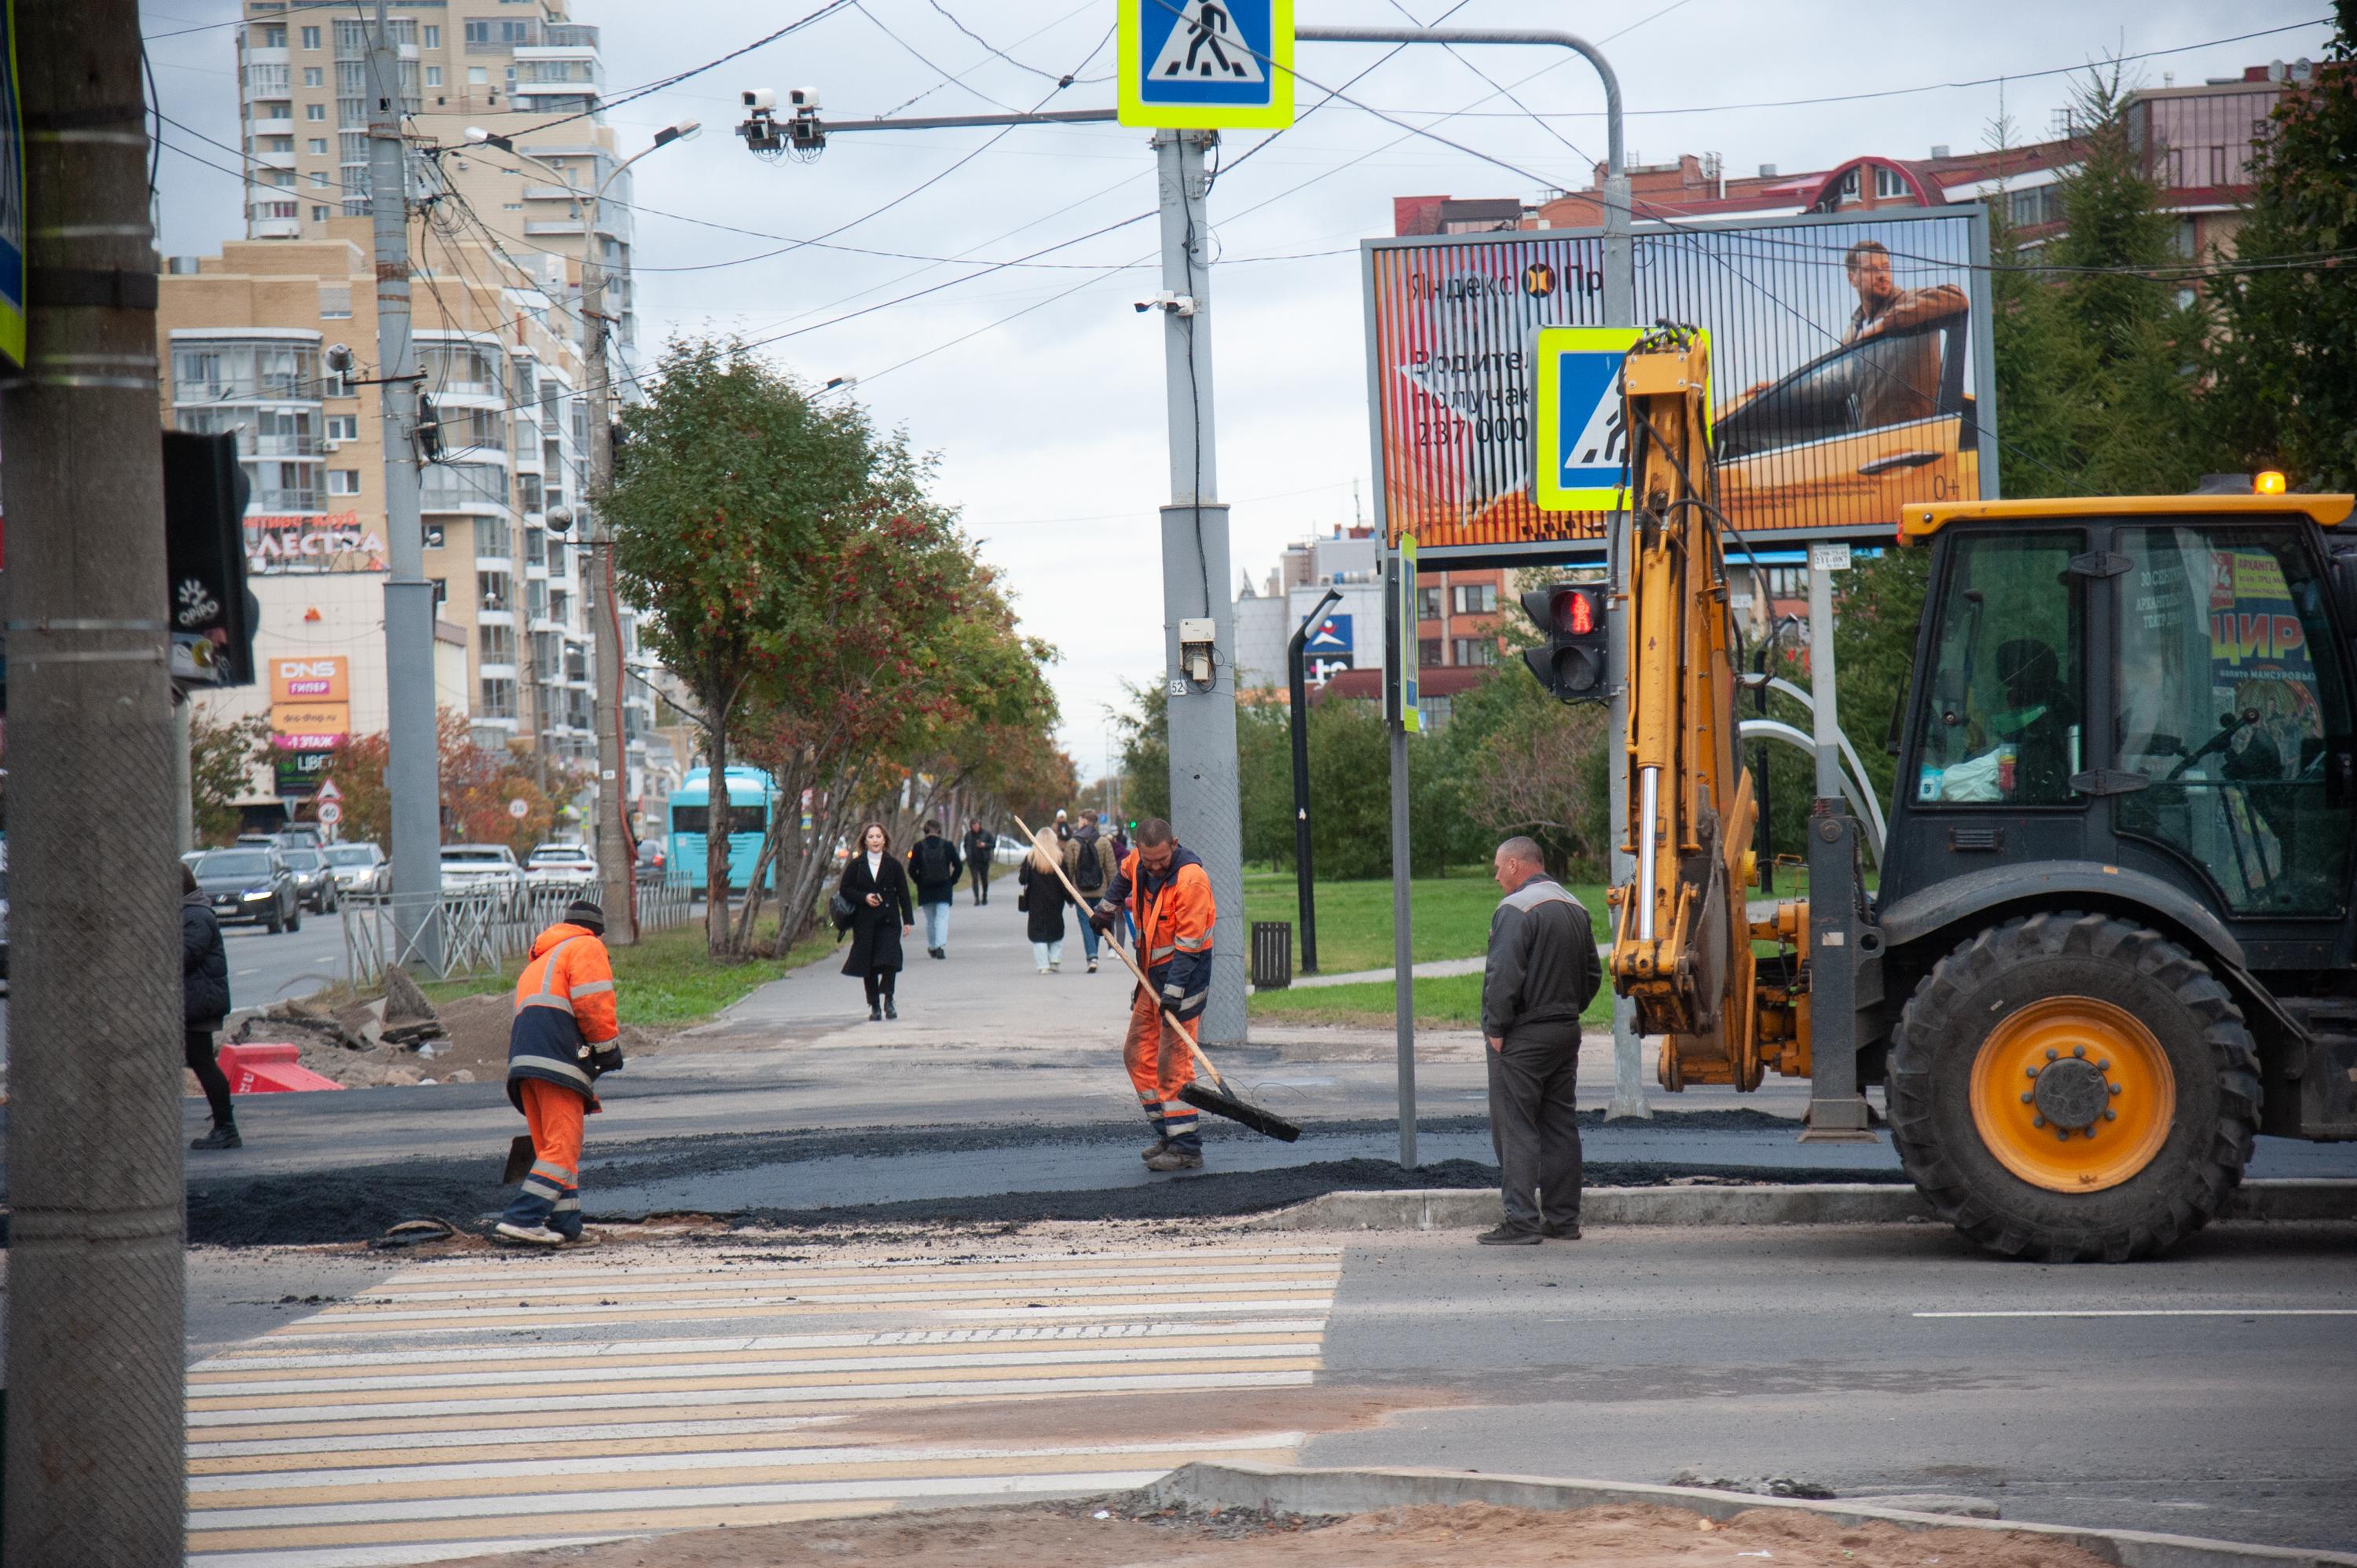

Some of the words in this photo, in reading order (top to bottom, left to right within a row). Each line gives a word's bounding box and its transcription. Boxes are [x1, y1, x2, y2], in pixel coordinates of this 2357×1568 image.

[1413, 273, 1512, 303] Яндекс
[1564, 265, 1604, 297] Пр
[1416, 419, 1466, 446] 237
[1475, 416, 1528, 443] 000
[1934, 474, 1959, 500] 0+
[2212, 614, 2312, 665] ЦИР
[280, 661, 335, 679] DNS
[291, 683, 328, 694] ГИПЕР
[1171, 682, 1183, 693] 52
[299, 735, 334, 748] ЭТАЖ
[322, 807, 337, 818] 40
